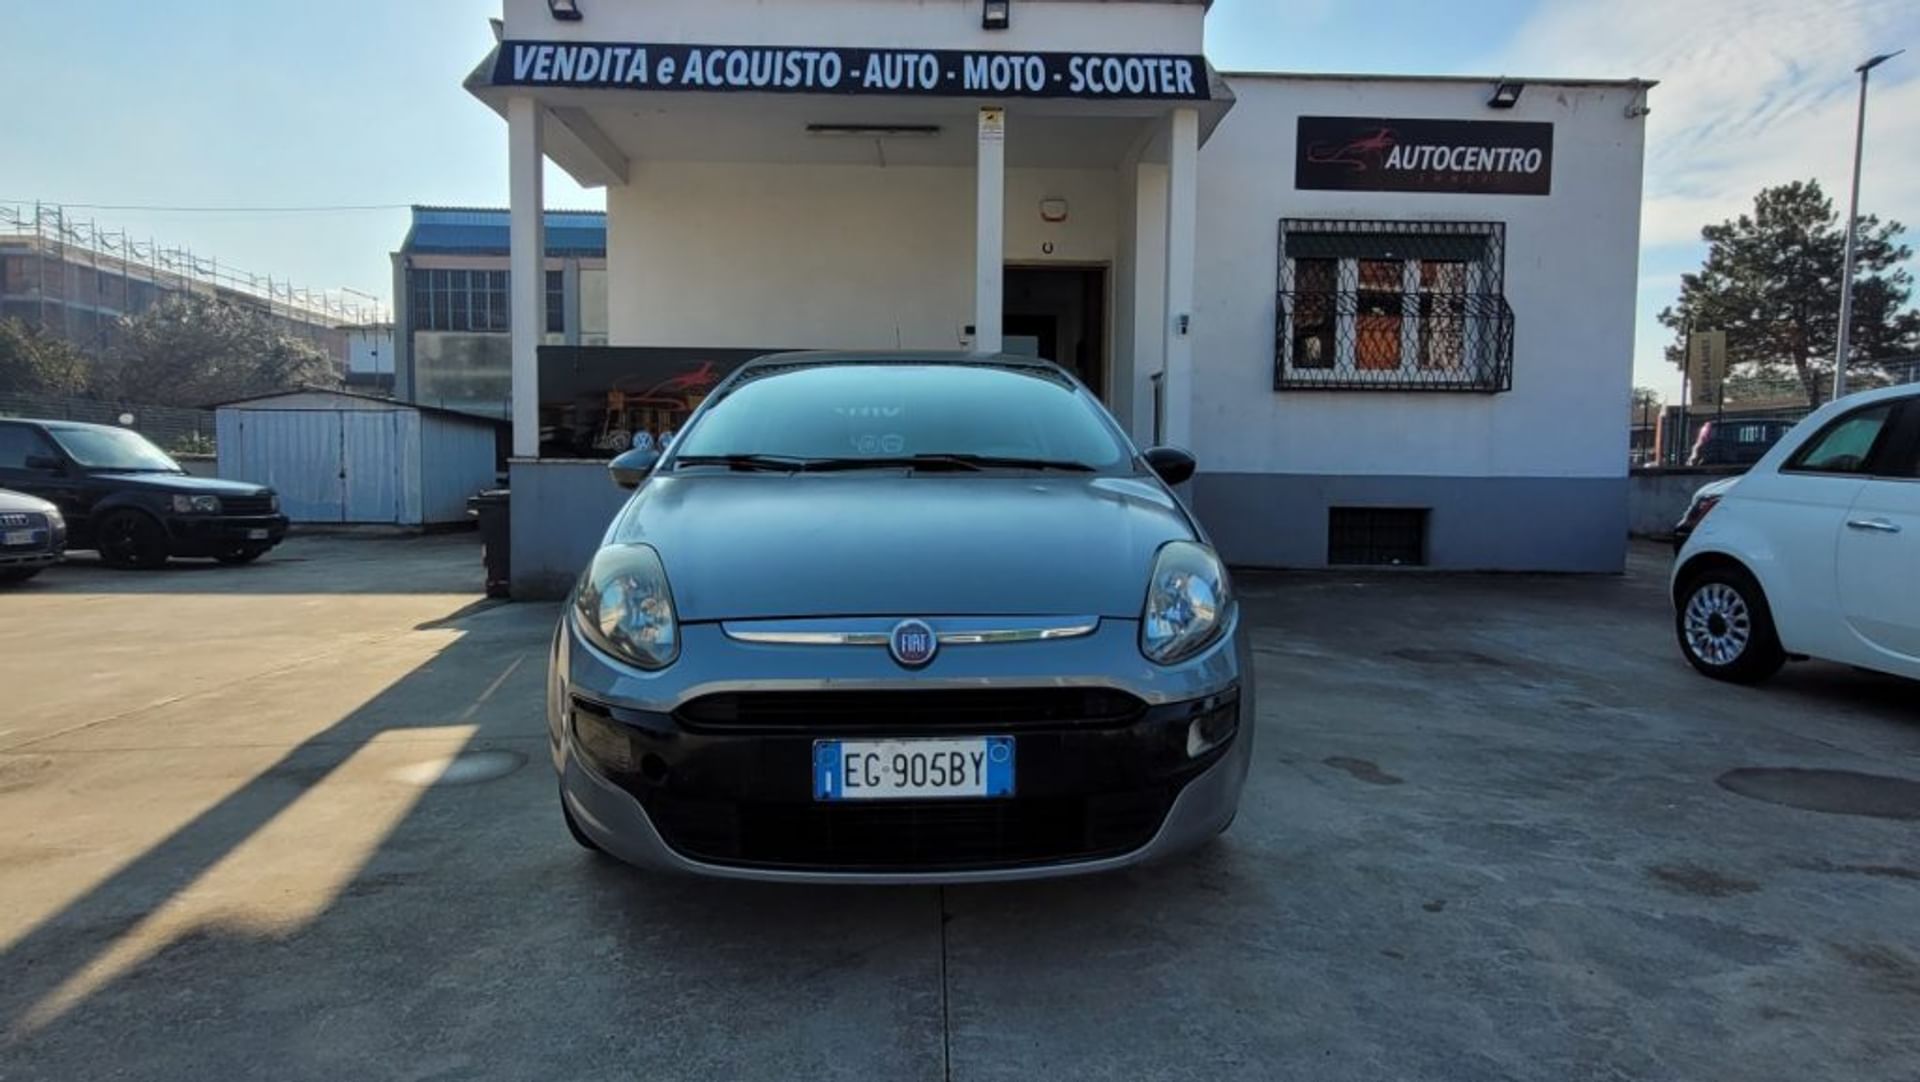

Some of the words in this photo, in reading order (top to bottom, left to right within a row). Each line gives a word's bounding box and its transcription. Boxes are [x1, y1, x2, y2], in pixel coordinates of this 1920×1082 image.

[513, 45, 648, 82] VENDITA
[656, 56, 675, 83] e
[681, 50, 842, 87] ACQUISTO
[963, 55, 1046, 91] MOTO
[1068, 57, 1195, 93] SCOOTER
[1384, 144, 1542, 173] AUTOCENTRO
[902, 633, 928, 653] FIAT
